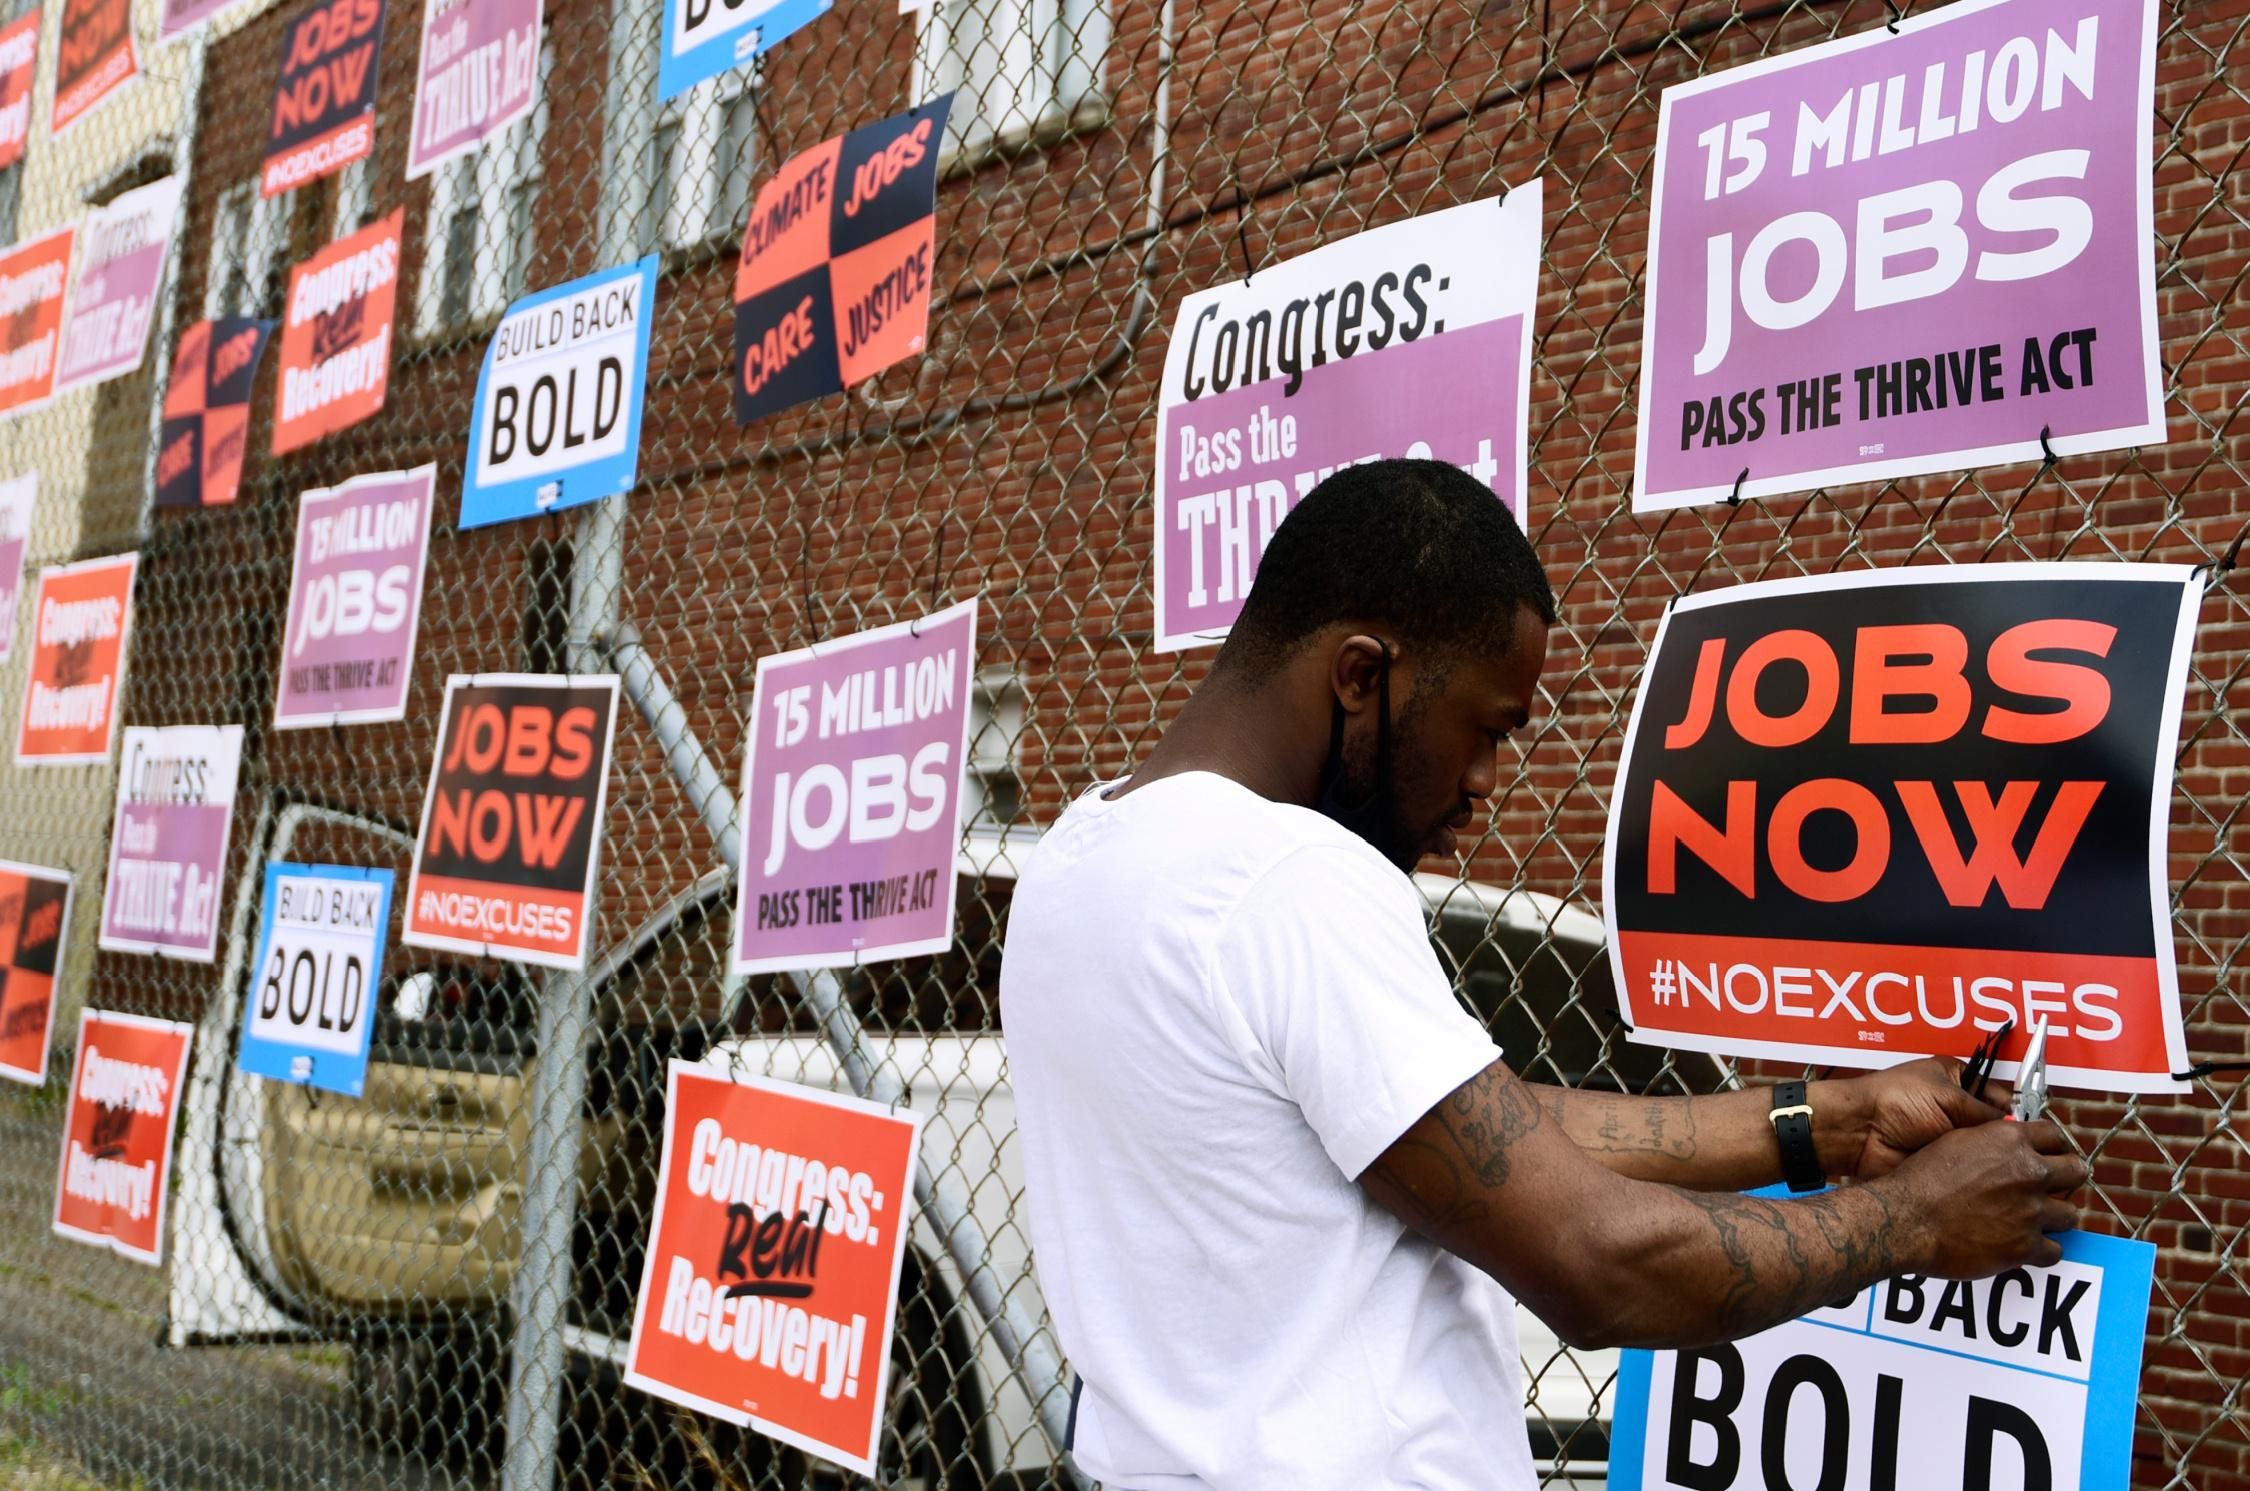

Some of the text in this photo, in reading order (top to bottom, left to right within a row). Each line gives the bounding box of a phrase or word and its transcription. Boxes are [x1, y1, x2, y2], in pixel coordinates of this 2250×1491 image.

[284, 0, 381, 77] JOBS
[273, 40, 375, 139] NOW
[1697, 15, 2099, 201] 15 MILLION
[743, 156, 831, 266] CLIMATE
[844, 118, 932, 217] JOBS
[845, 241, 928, 356] JUSTICE
[1694, 149, 2093, 376] JOBS
[496, 283, 637, 362] BUILD BACK
[744, 295, 814, 395] CARE
[1184, 263, 1451, 401] Congress:
[489, 356, 622, 465] BOLD
[1681, 327, 2096, 451] PASS THE THRIVE ACT
[1179, 405, 1297, 481] Pass the
[310, 498, 419, 565] 15 MILLION
[293, 564, 410, 658] JOBS
[774, 648, 956, 748] 15 MILLION
[1664, 618, 2118, 749] JOBS
[444, 703, 597, 780] JOBS
[428, 788, 585, 870] NOW
[764, 741, 949, 877] JOBS
[1647, 778, 2107, 910] NOW
[419, 890, 572, 941] #NOEXCUSES
[758, 869, 937, 931] PASS THE THRIVE ACT
[261, 947, 362, 1033] BOLD
[1649, 959, 2123, 1041] #NOEXCUSES
[687, 1118, 884, 1245] Congress:
[718, 1199, 828, 1280] Real
[659, 1255, 866, 1400] Recovery!
[1884, 1265, 2092, 1362] BACK
[1665, 1341, 2053, 1491] BOLD
